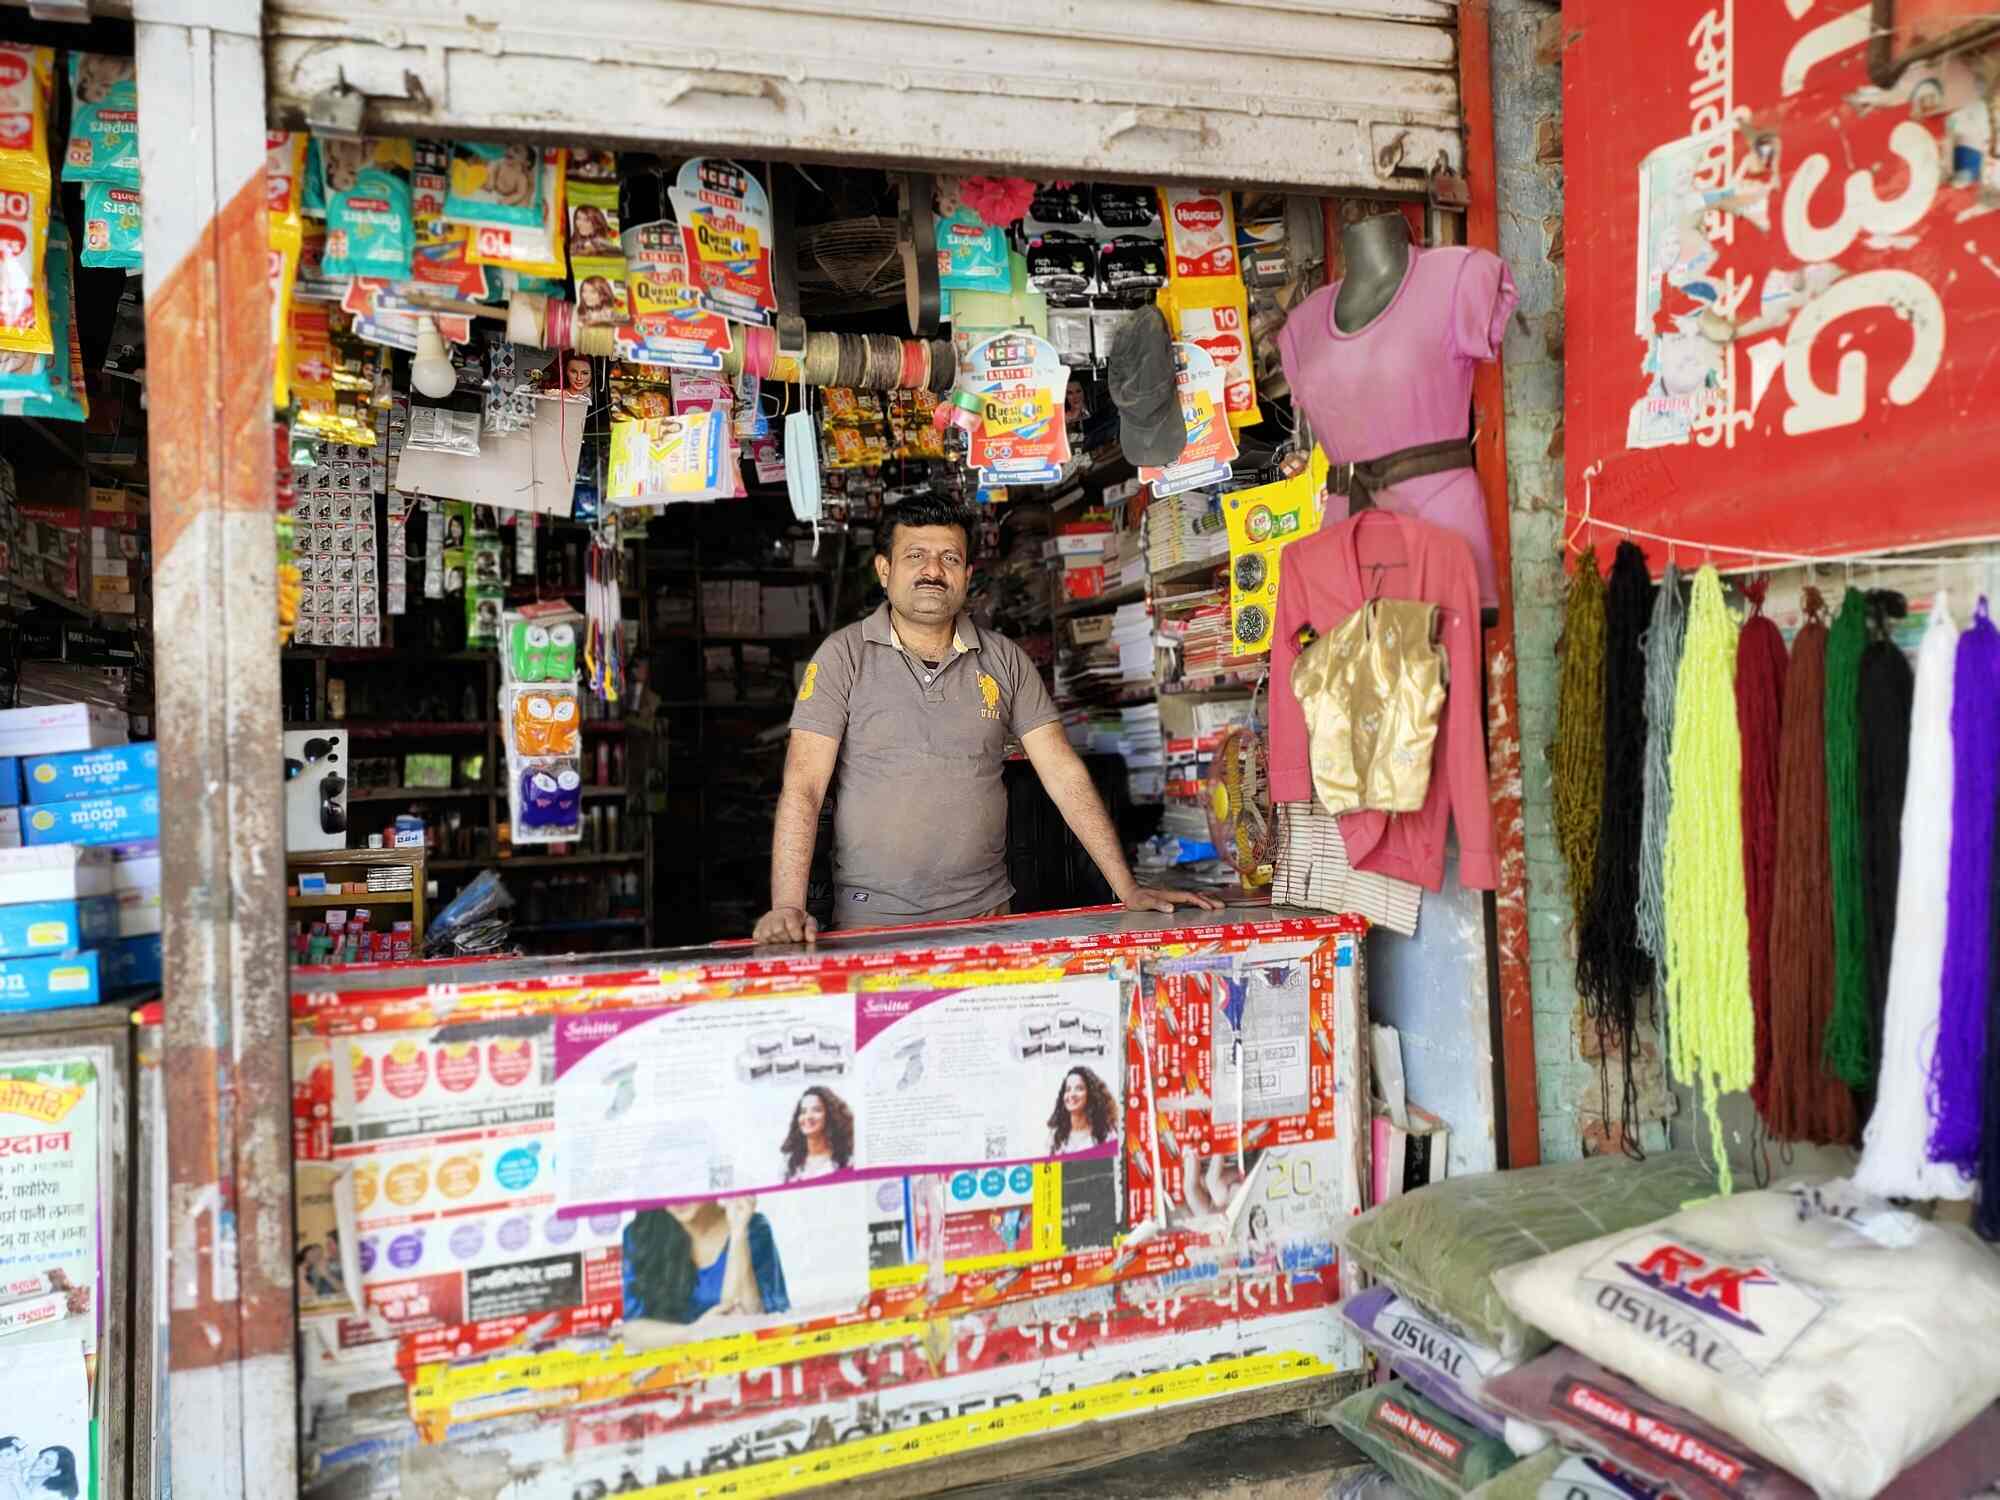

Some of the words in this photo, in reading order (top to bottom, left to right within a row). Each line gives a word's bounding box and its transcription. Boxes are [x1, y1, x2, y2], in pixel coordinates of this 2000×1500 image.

[90, 121, 138, 136] mpers
[1782, 121, 1946, 436] 3G
[1215, 308, 1239, 326] 10
[985, 344, 1038, 361] NCERT
[72, 760, 129, 777] moon
[70, 806, 129, 824] moon
[0, 1131, 72, 1158] रदान
[1596, 1285, 1723, 1374] OSWAL
[1391, 1318, 1465, 1379] OSWAL
[1297, 1357, 1311, 1367] 4G
[1223, 1370, 1240, 1380] 4G
[1069, 1399, 1087, 1411] 4G
[987, 1418, 1006, 1430] 4G
[1572, 1388, 1632, 1429] Ganesh
[1634, 1415, 1681, 1454] Wool
[1679, 1436, 1735, 1481] Store
[901, 1438, 920, 1451] 4G
